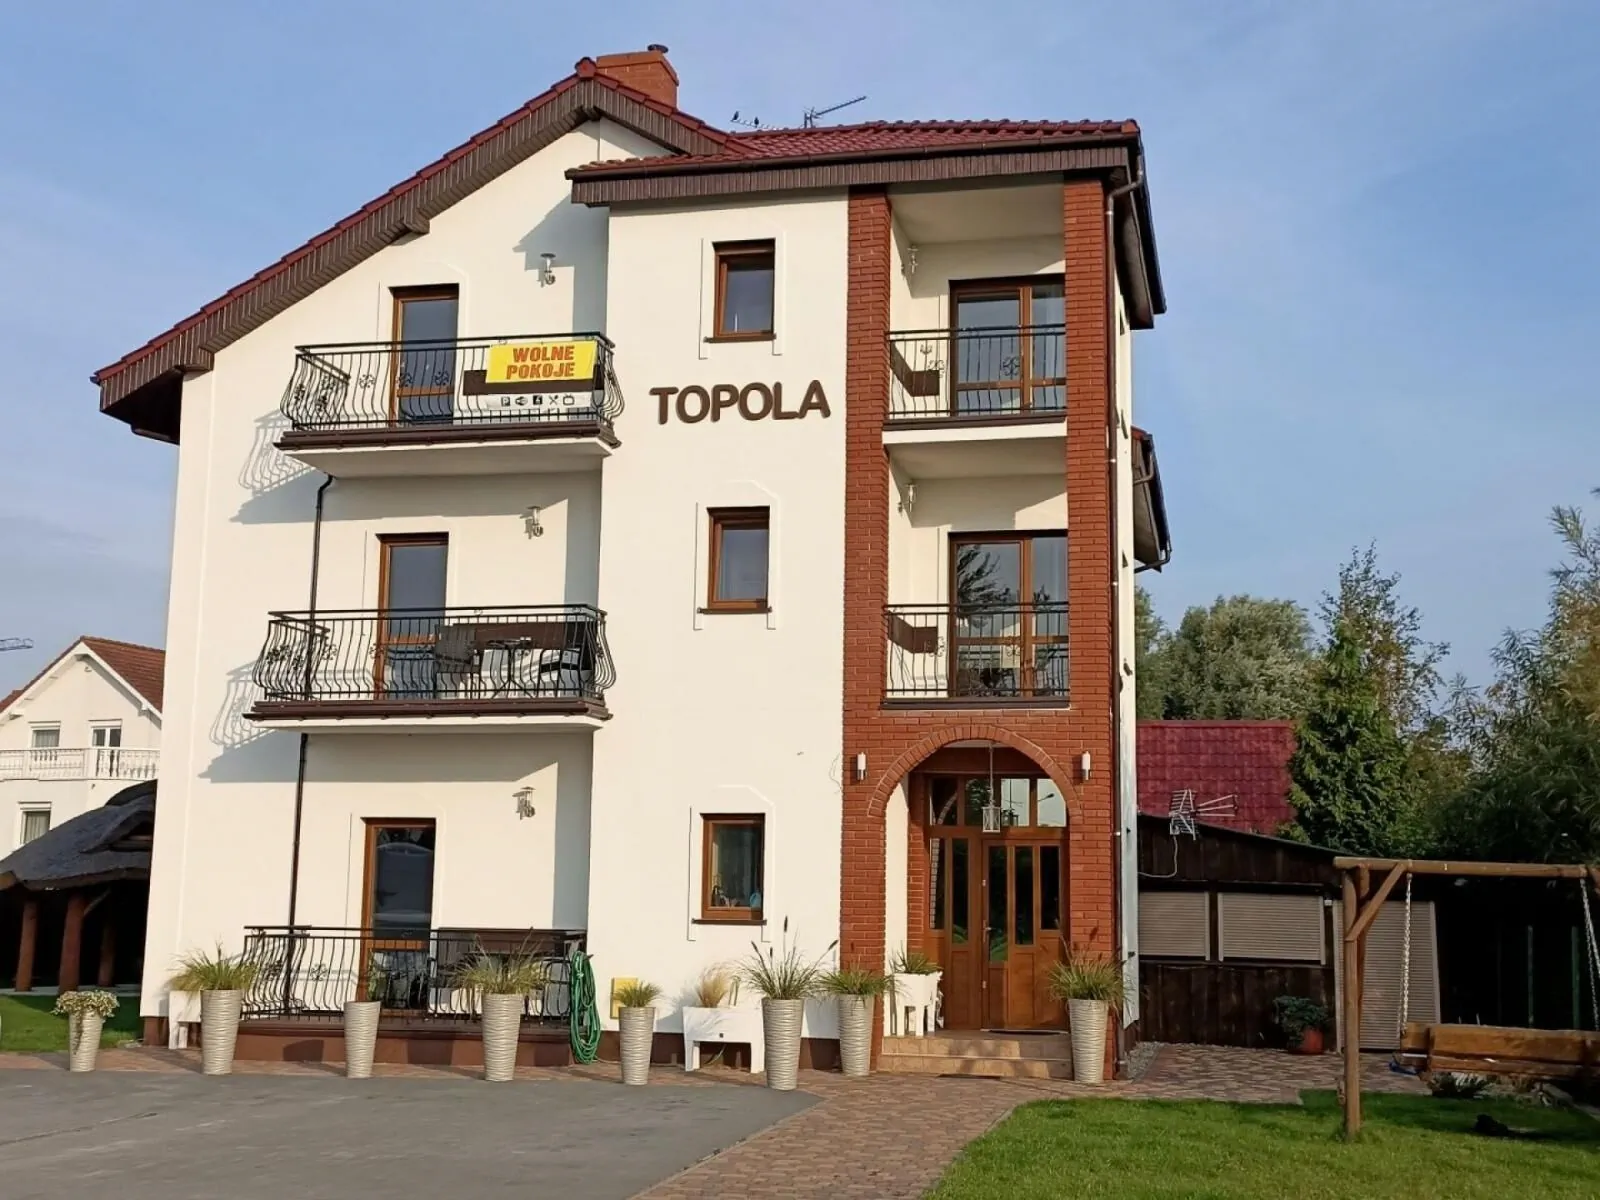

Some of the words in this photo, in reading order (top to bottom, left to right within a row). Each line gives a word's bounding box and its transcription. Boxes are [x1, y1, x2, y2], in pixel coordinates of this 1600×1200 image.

[513, 346, 574, 363] WOLNE
[506, 362, 574, 379] POKOJE
[649, 380, 831, 425] TOPOLA
